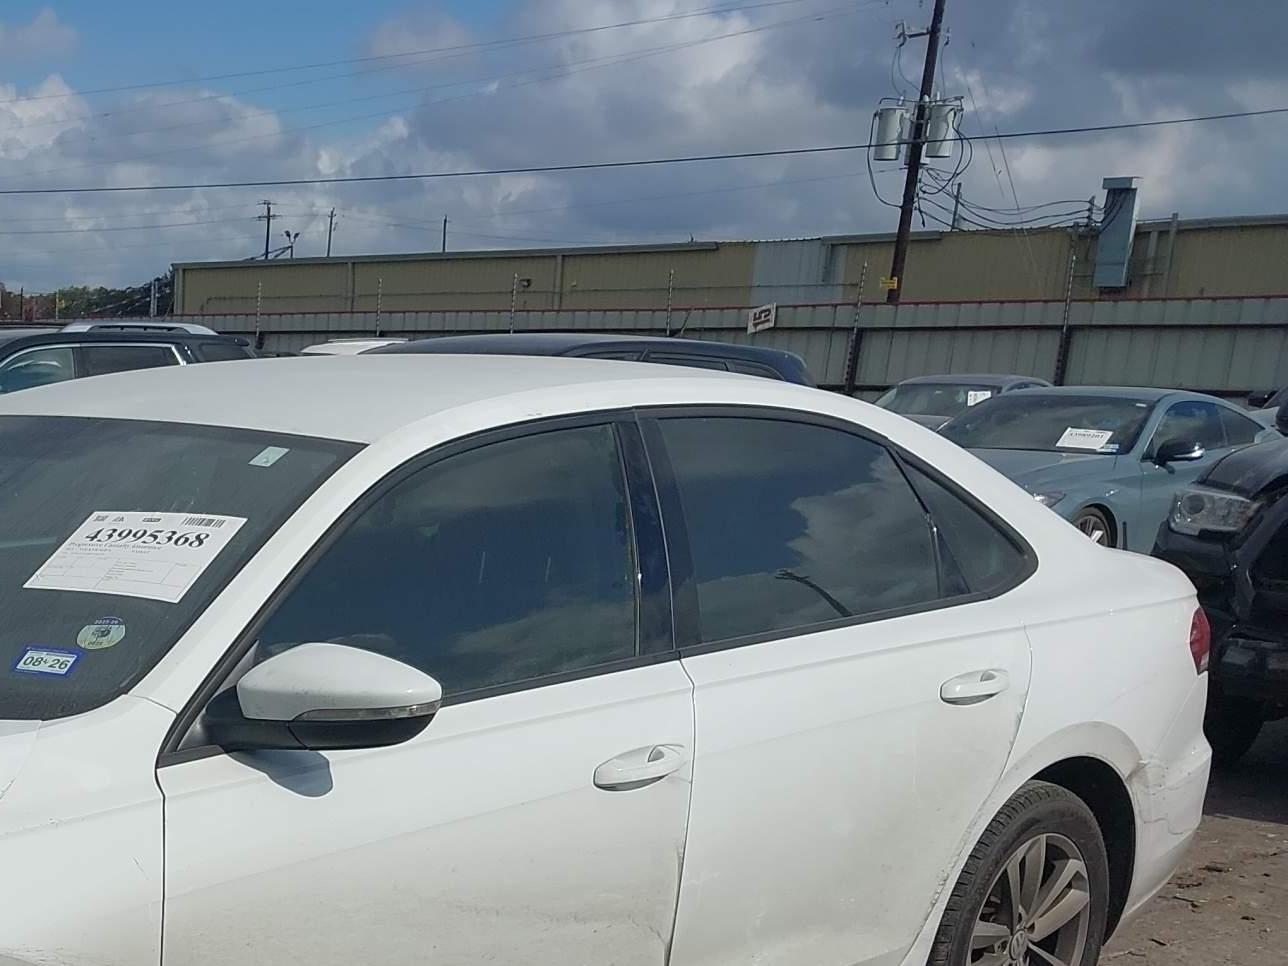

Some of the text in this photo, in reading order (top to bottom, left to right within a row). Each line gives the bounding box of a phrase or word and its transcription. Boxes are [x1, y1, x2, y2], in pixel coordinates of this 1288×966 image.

[85, 527, 210, 549] 43995368
[23, 656, 71, 671] 08 26
